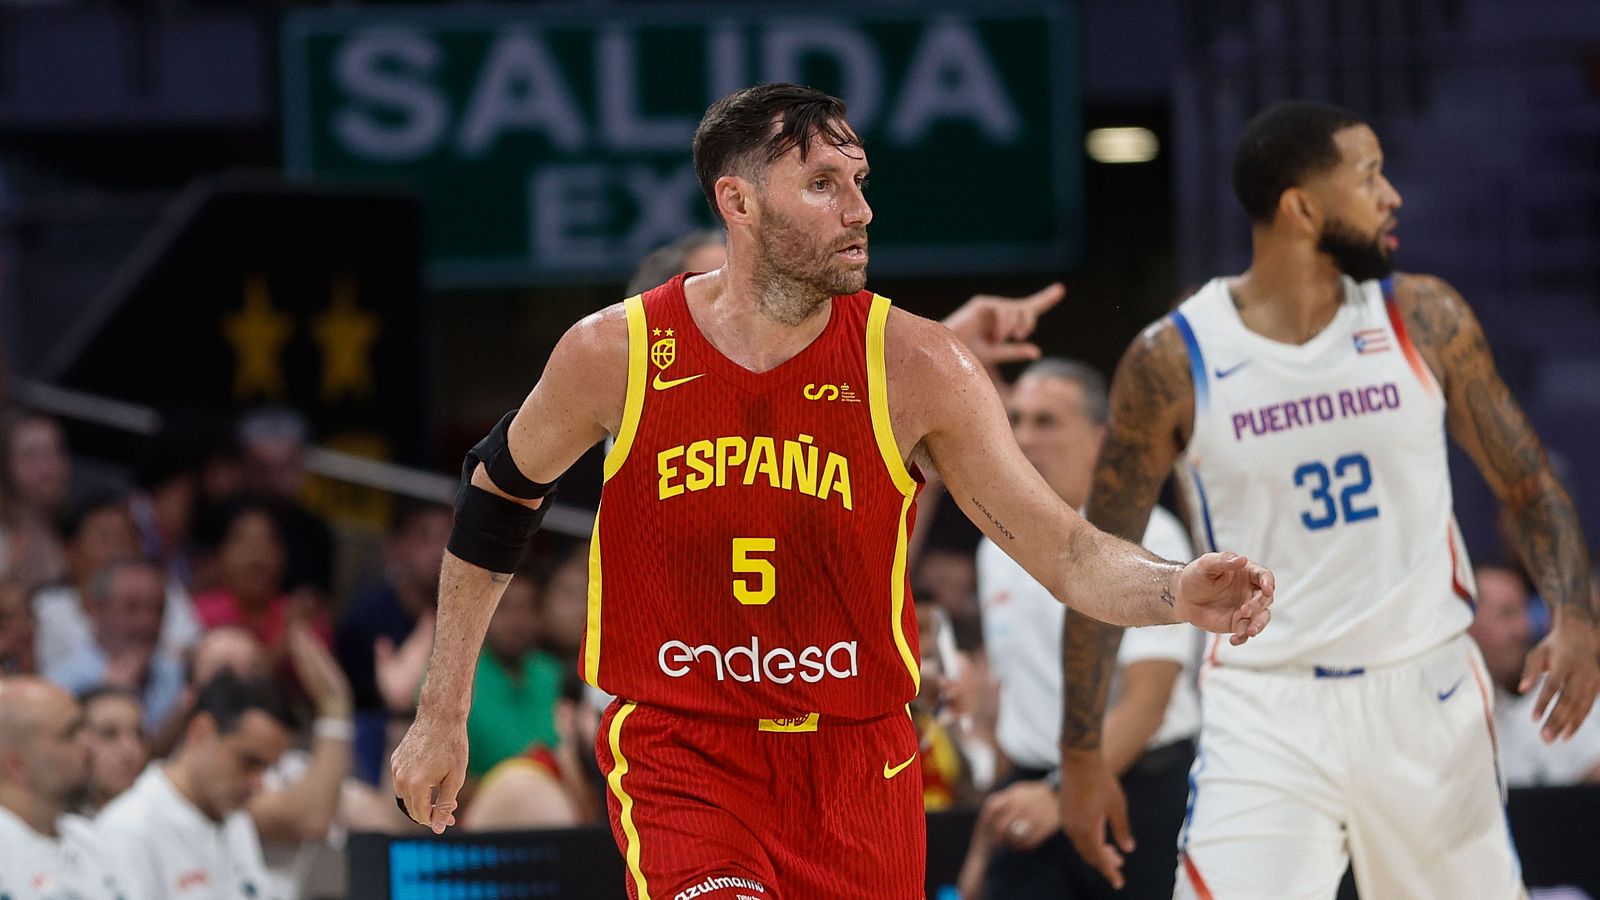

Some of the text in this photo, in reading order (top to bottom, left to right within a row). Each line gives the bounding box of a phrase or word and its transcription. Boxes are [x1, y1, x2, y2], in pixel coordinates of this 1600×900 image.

[333, 20, 1024, 157] SALIDA
[528, 163, 703, 266] EX
[1232, 382, 1401, 441] PUERTO RICO
[657, 433, 853, 511] ESPAÑA
[1293, 453, 1379, 531] 32
[732, 537, 776, 605] 5
[657, 635, 858, 685] endesa
